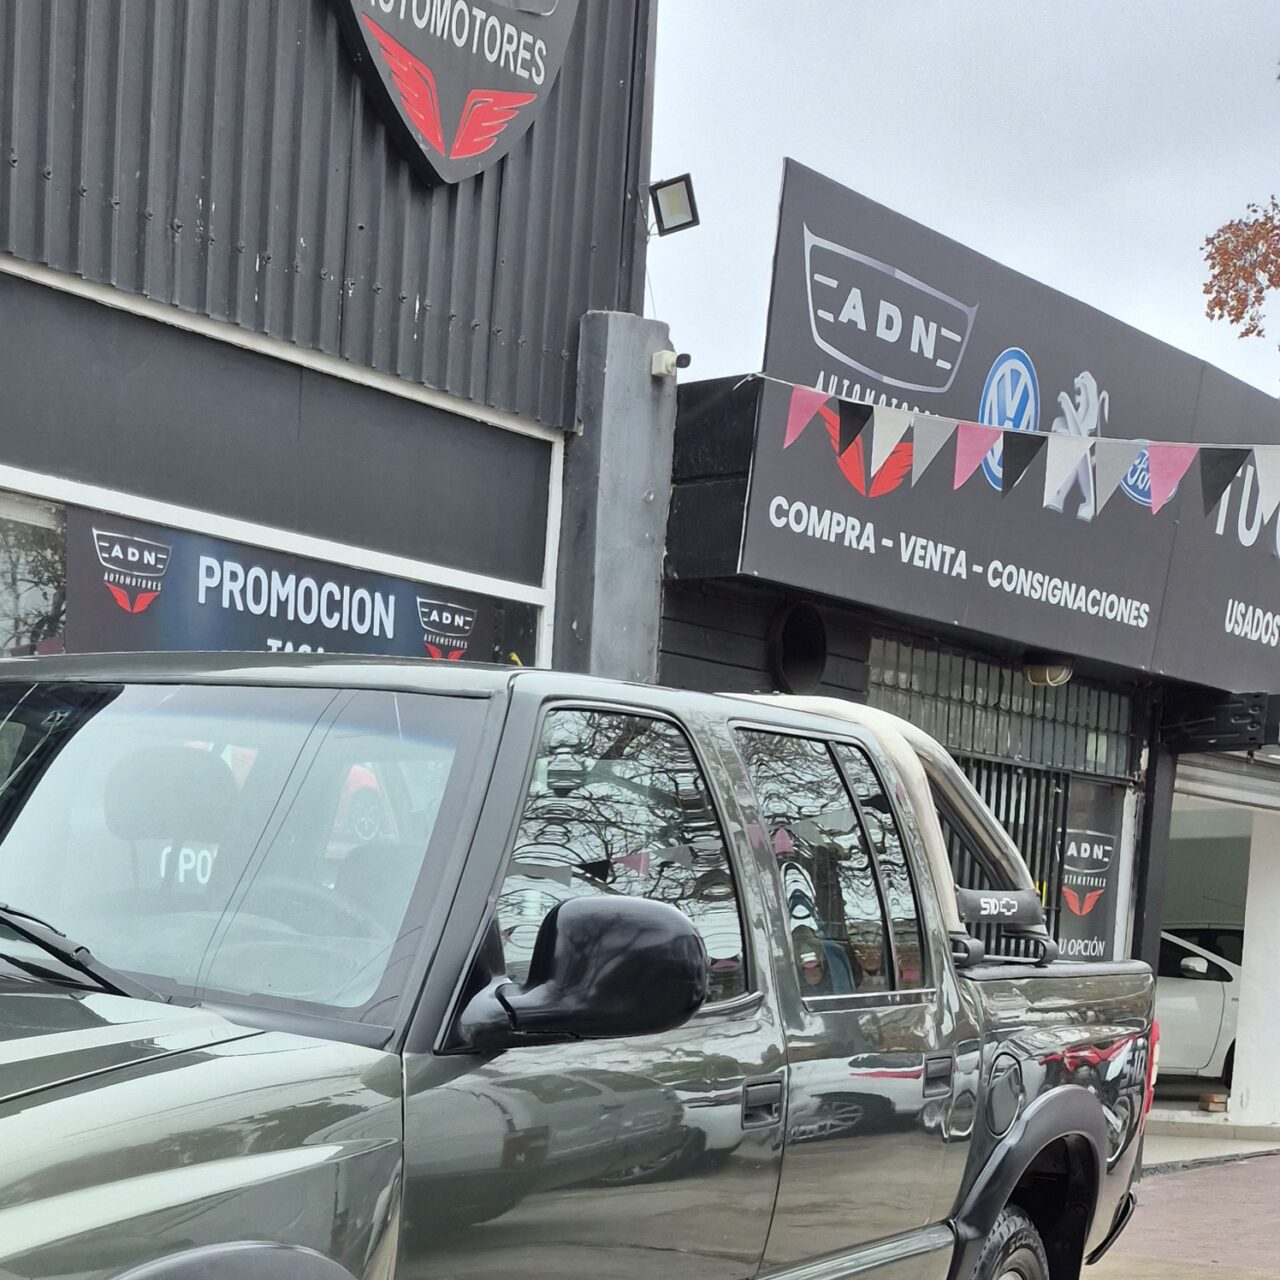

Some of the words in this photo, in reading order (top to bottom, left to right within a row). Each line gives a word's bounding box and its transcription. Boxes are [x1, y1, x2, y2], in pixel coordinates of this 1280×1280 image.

[370, 0, 547, 85] OMOTORES
[838, 287, 937, 361] ADN
[111, 544, 156, 566] ADN
[769, 495, 876, 553] COMPRA
[899, 532, 967, 579] VENTA
[987, 560, 1150, 629] CONSIGNACIONES
[103, 572, 162, 591] AUTOMOTORES
[198, 555, 396, 639] PROMOCION
[430, 610, 464, 627] ADN
[1224, 599, 1280, 647] USADOS
[1067, 841, 1104, 860] ADN
[1064, 874, 1107, 887] UTOMOTORES
[1068, 936, 1105, 956] OPCIÓN
